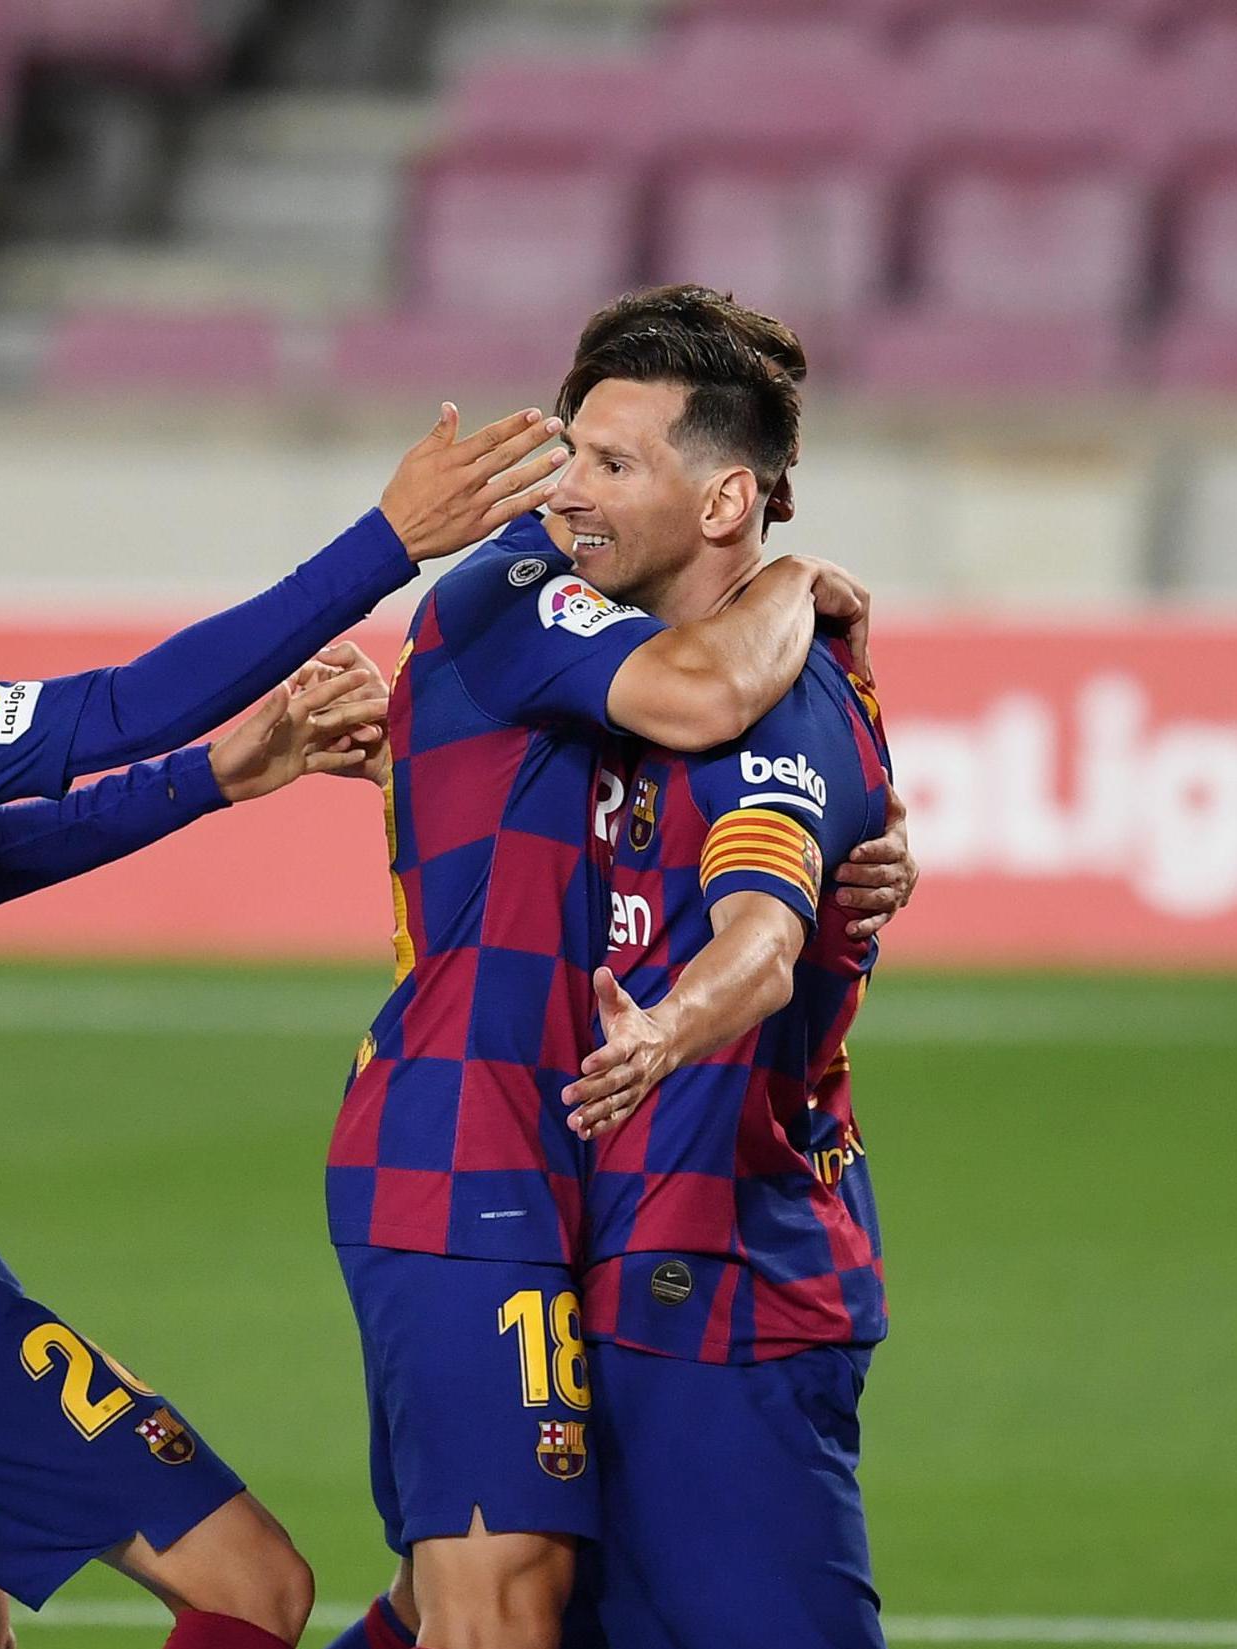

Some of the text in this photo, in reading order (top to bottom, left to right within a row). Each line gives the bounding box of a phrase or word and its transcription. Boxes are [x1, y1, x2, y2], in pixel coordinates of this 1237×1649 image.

[581, 603, 635, 630] LaLiga
[1, 684, 26, 735] LaLiga
[740, 750, 827, 808] beko
[498, 1290, 592, 1412] 18
[19, 1322, 157, 1442] 2
